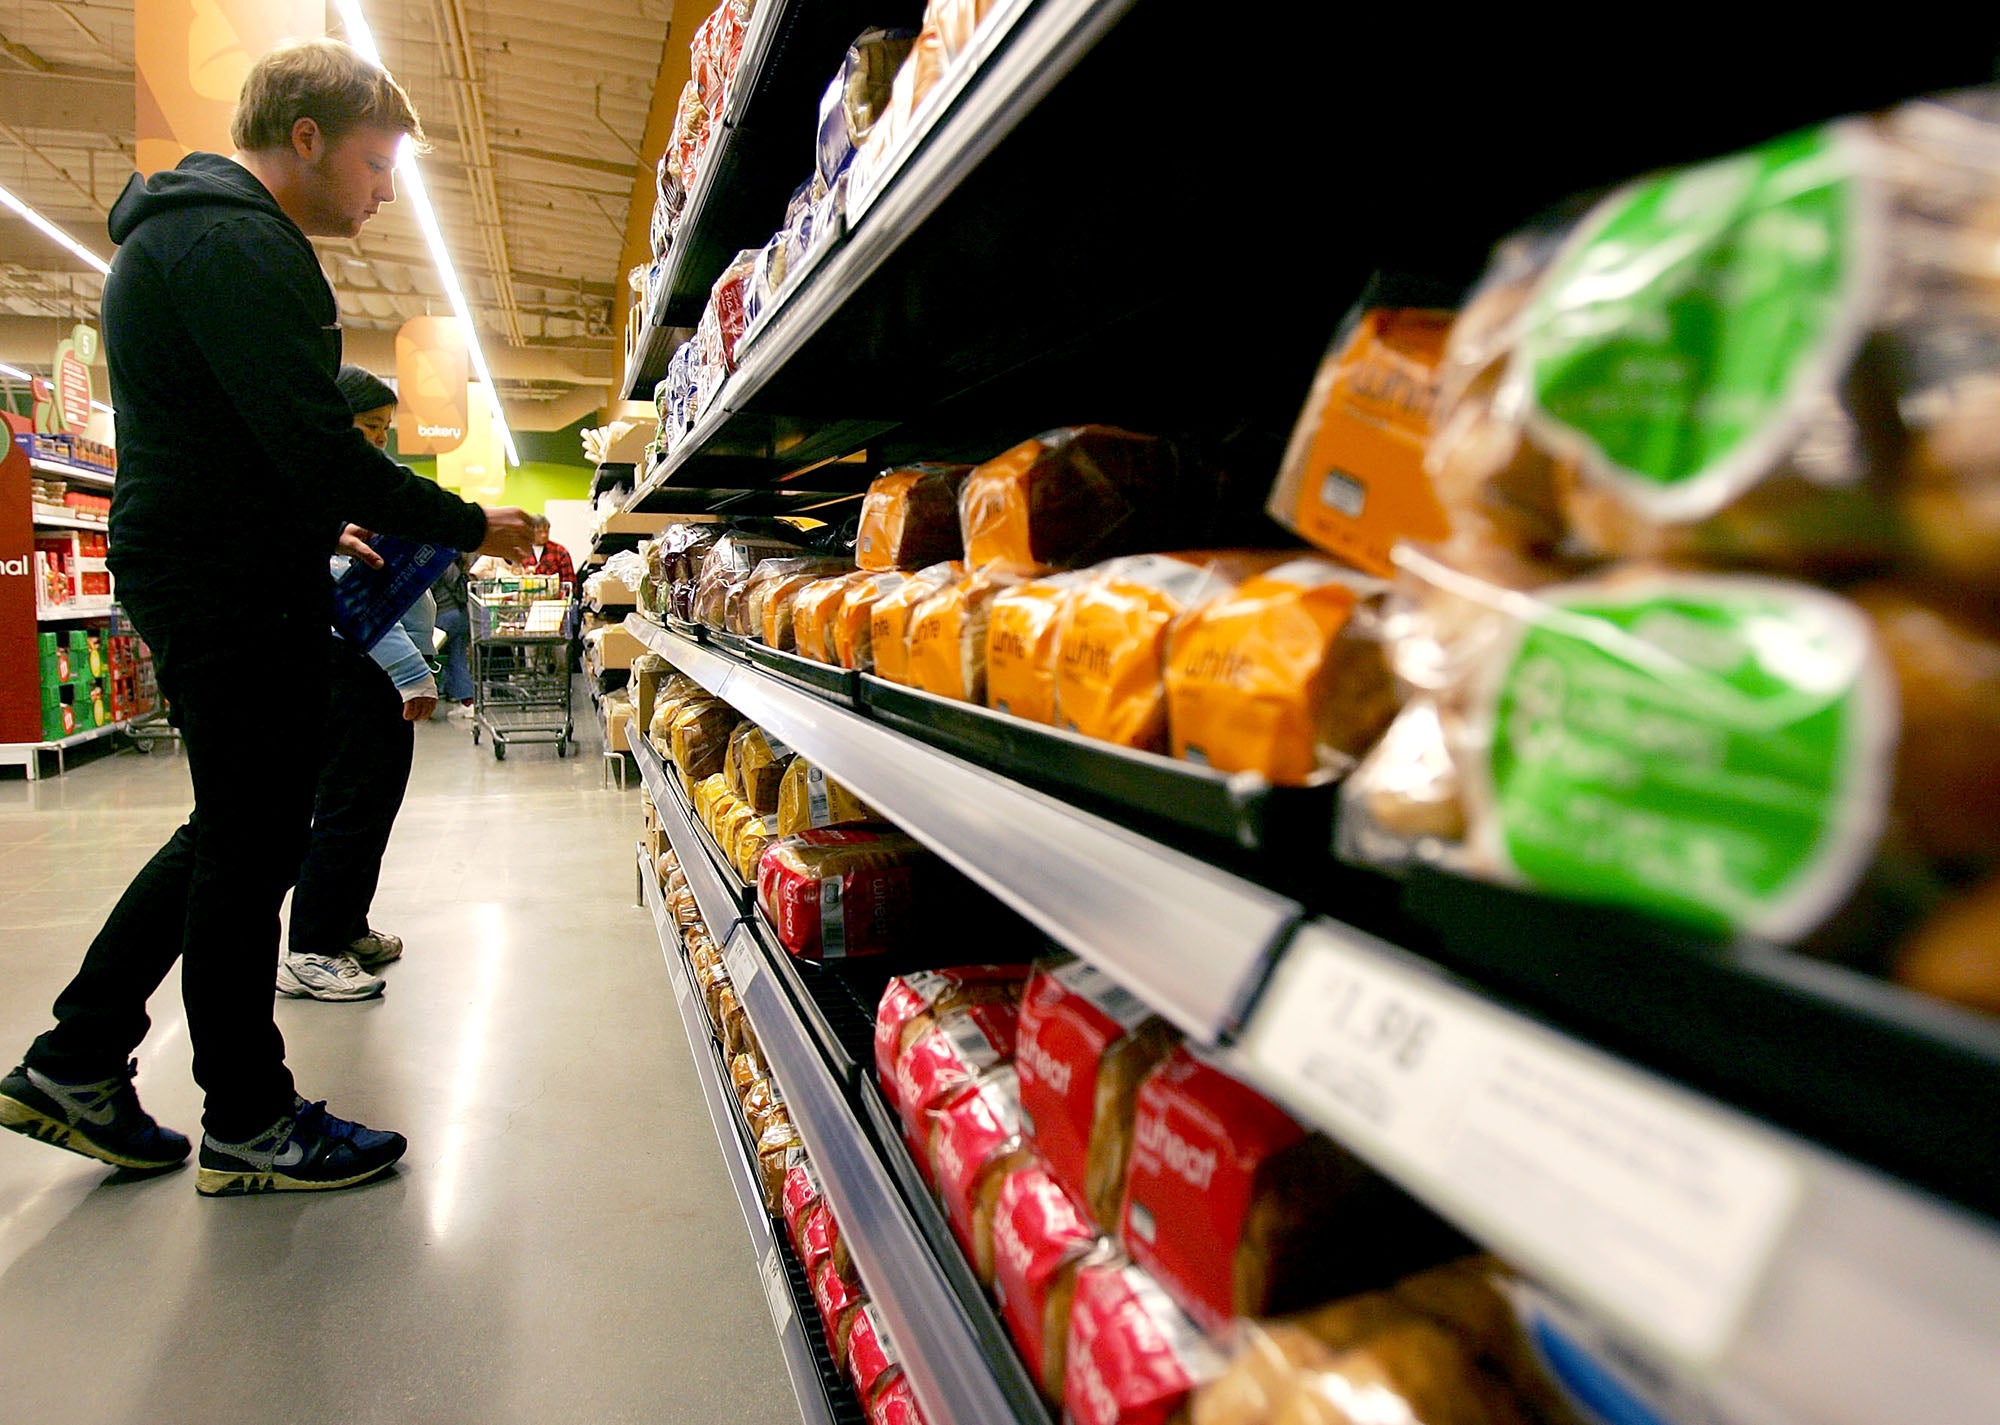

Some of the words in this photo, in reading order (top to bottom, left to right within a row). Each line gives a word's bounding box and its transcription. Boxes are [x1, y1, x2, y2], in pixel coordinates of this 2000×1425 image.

[417, 424, 461, 440] bakery
[783, 879, 796, 938] wheat
[1135, 1112, 1218, 1191] wheat
